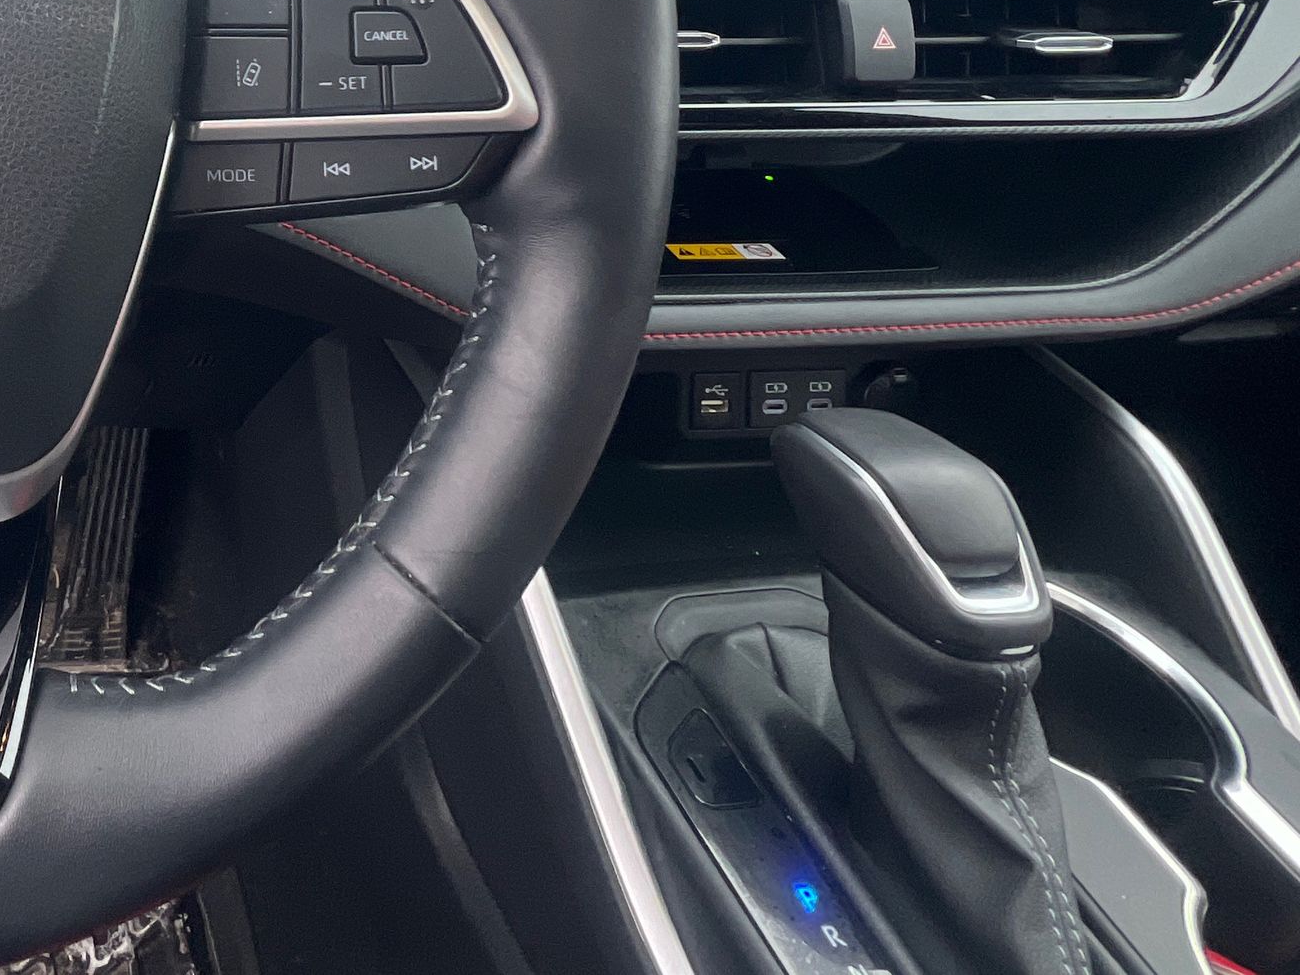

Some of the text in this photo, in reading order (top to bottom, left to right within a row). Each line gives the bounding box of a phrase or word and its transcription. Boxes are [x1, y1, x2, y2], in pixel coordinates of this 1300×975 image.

[364, 30, 409, 41] CANCEL
[206, 168, 256, 182] MODE
[794, 883, 818, 913] P
[821, 924, 848, 948] R
